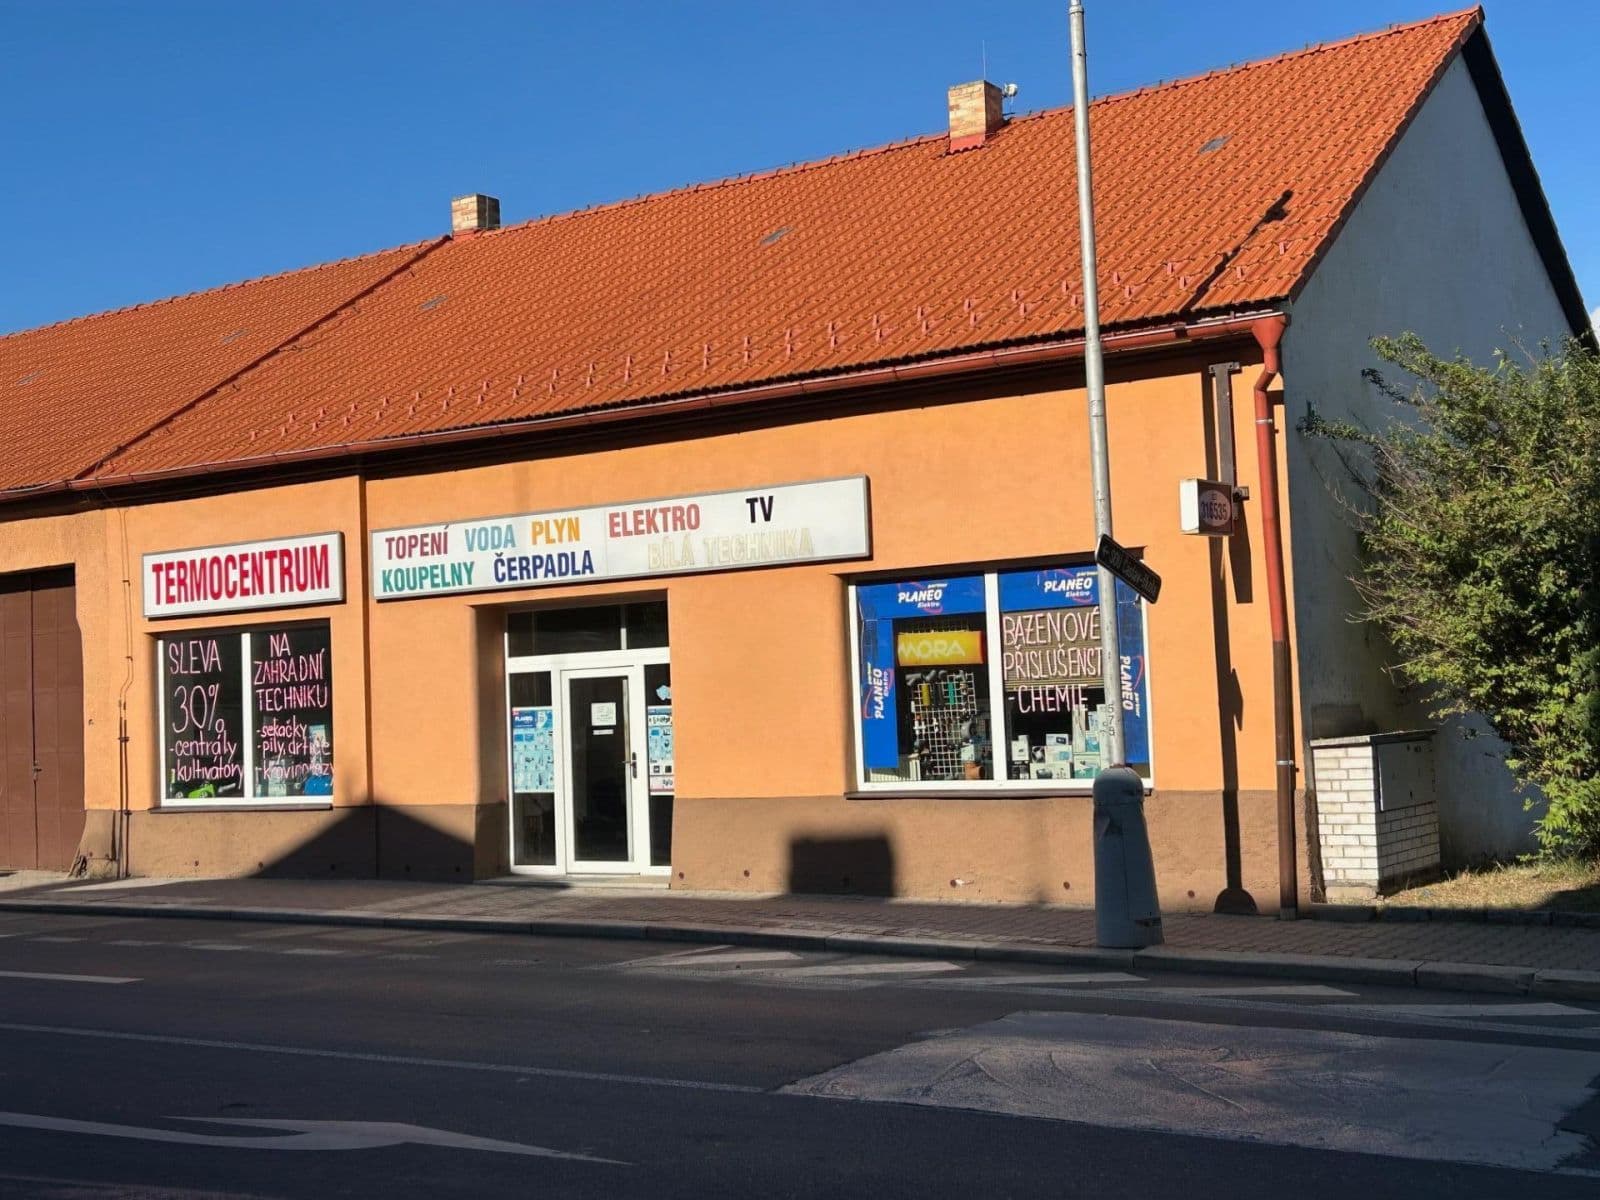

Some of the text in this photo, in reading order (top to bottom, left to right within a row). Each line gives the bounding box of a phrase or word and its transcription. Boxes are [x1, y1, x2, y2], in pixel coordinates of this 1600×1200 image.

[608, 495, 774, 538] ELEKTRO TV
[385, 517, 580, 560] TOPENÍ VODA PLYN
[648, 527, 814, 569] BÍLÁ TECHNIKA
[152, 544, 330, 605] TERMOCENTRUM
[382, 550, 594, 593] KOUPELNY ČERPADLA
[1044, 577, 1093, 593] PLANEO
[898, 589, 943, 604] PLANEO
[168, 639, 222, 675] SLEVA
[270, 632, 291, 658] NA
[897, 639, 966, 659] MORA
[1003, 643, 1104, 681] PŘISLUŠENST
[253, 648, 325, 685] ZAHRADNÍ
[1120, 655, 1135, 710] PLANEO
[172, 683, 225, 734] 30%
[256, 683, 328, 712] TECHNIKU
[873, 668, 885, 719] PLANEO
